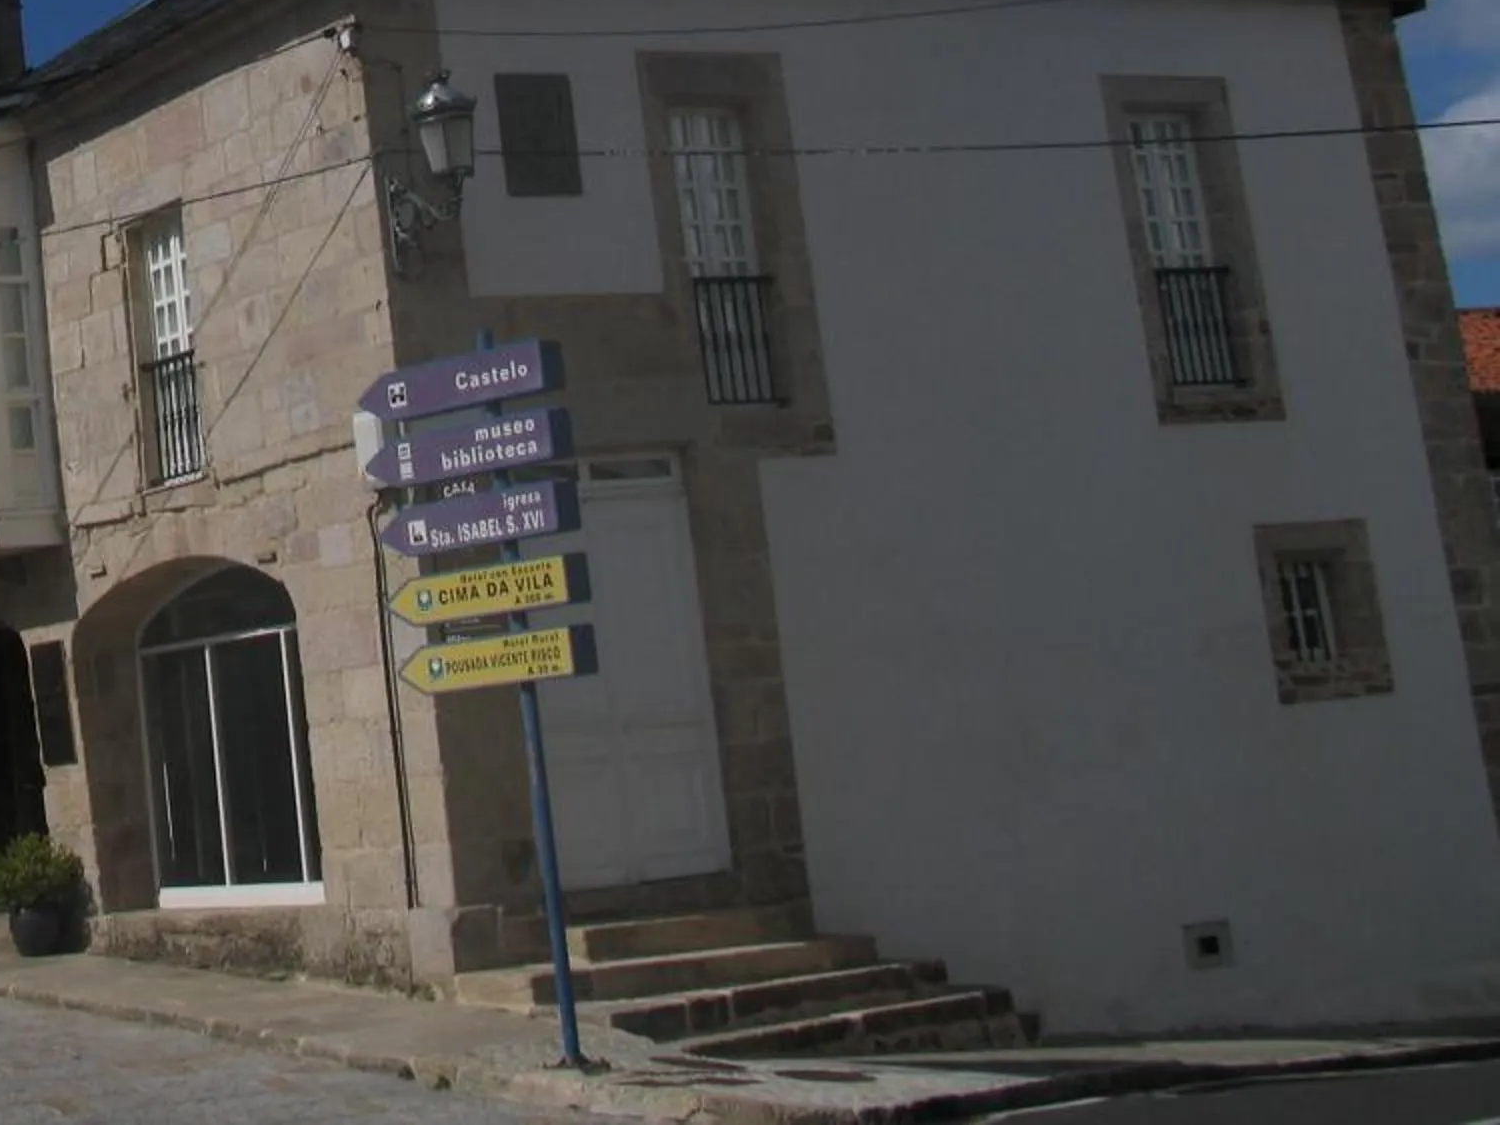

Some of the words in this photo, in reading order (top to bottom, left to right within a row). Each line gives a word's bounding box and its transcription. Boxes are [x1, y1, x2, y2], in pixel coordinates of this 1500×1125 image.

[455, 360, 528, 390] Castelo
[475, 419, 535, 442] museo
[441, 439, 538, 471] biblioteca
[457, 517, 503, 543] ISABEL
[505, 514, 519, 534] S.
[521, 509, 545, 531] XVI
[438, 585, 480, 605] CIMA
[486, 581, 509, 597] DA
[515, 572, 553, 593] VILA
[445, 655, 488, 676] POUSADA
[490, 651, 528, 668] VICENTE
[530, 645, 561, 664] RISCO
